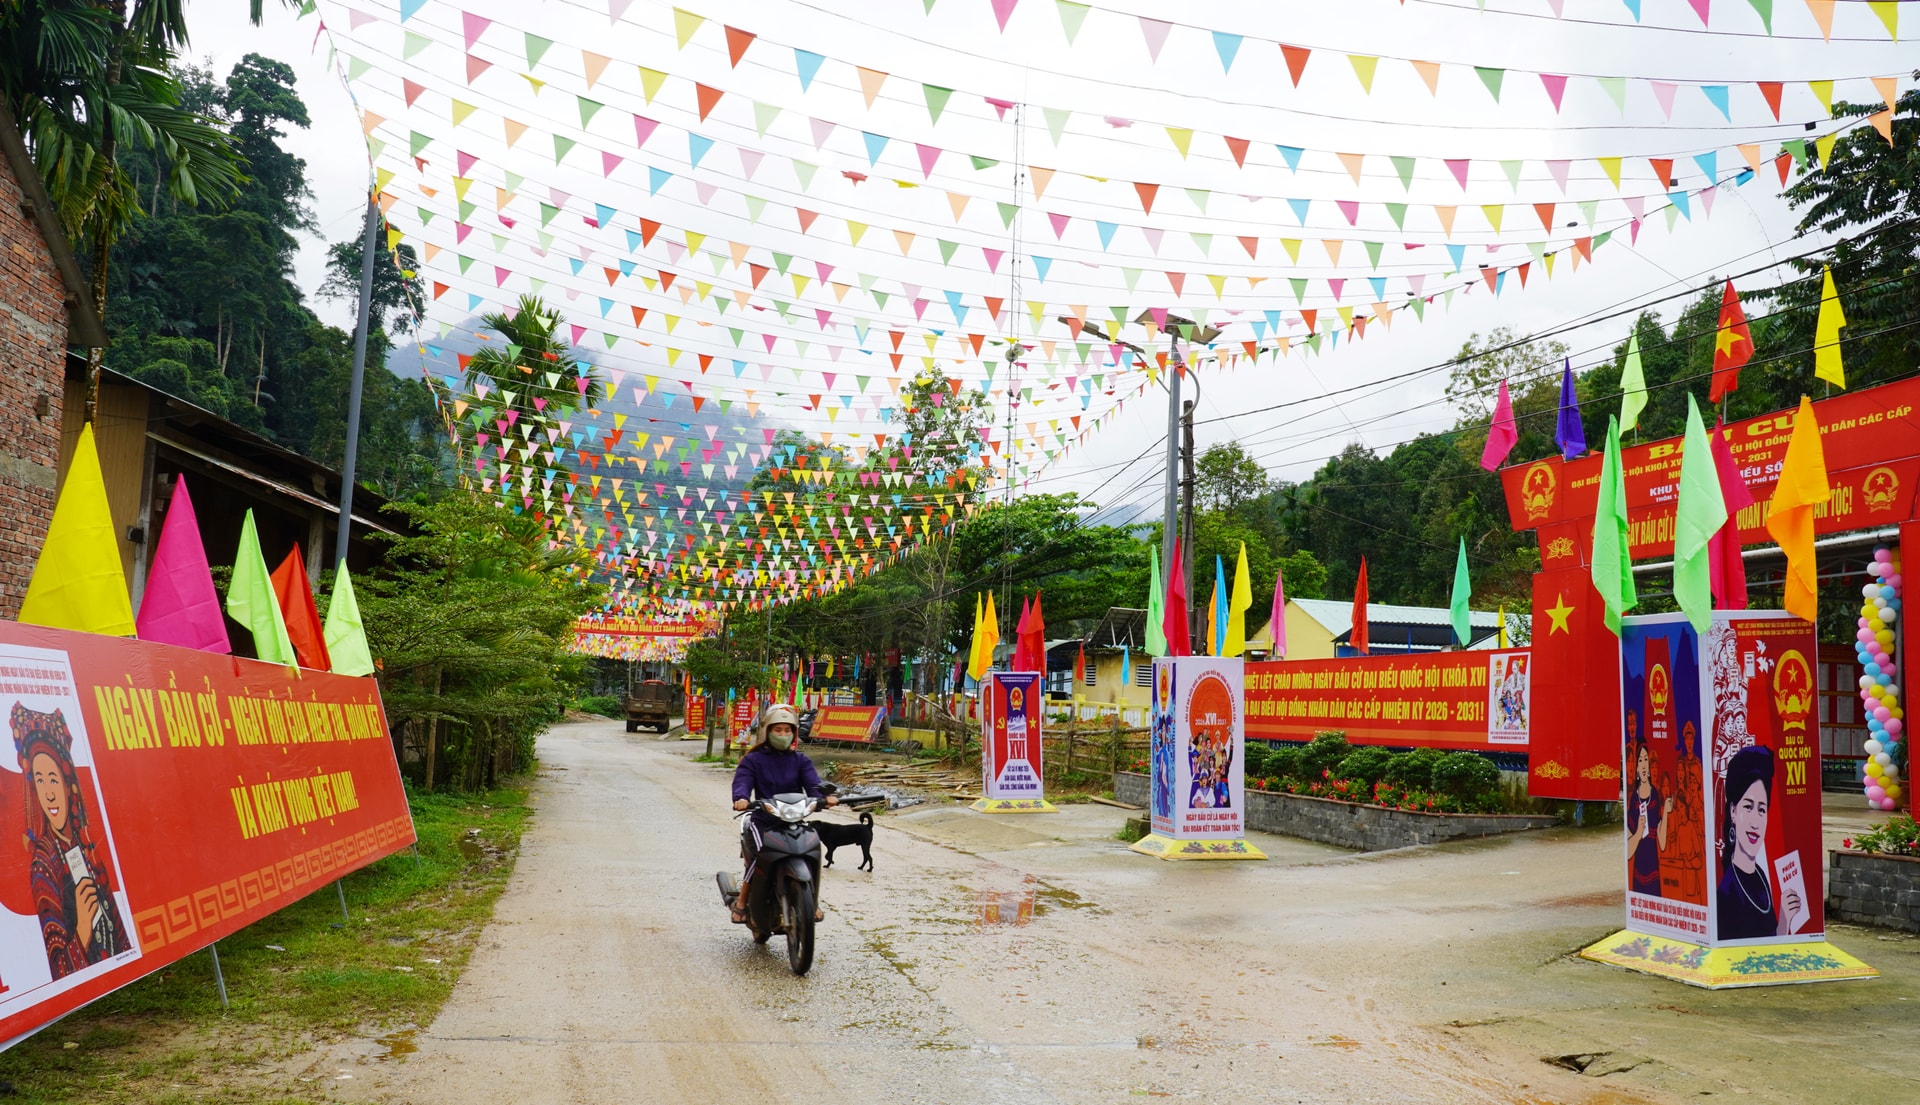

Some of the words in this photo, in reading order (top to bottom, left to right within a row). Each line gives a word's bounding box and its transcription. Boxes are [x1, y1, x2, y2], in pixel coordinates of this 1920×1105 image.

[1586, 473, 1601, 485] BIỂ
[1670, 458, 1682, 467] XV
[1831, 419, 1856, 432] DÂN
[1859, 413, 1883, 426] CÁC
[1886, 404, 1912, 419] CẤP
[1748, 451, 1772, 463] 2031
[1649, 484, 1672, 496] KHU
[1641, 512, 1656, 545] BẦU
[1658, 509, 1669, 542] CỬ
[1260, 671, 1273, 693] LIỆT
[1274, 670, 1291, 689] CHÀO
[1292, 669, 1312, 689] MỪNG
[1313, 668, 1333, 689] NGÀY
[1334, 665, 1350, 689] BẦU
[1351, 665, 1363, 689] CỬ
[1363, 670, 1378, 692] ĐẠI
[1379, 662, 1398, 688] BIỂU
[1400, 662, 1423, 690] QUỐC
[1425, 664, 1440, 692] HỘI
[1442, 663, 1467, 687] KHÓA
[1470, 666, 1486, 687] XVI
[93, 674, 162, 750] NGÀY
[158, 670, 201, 748] BẦU
[196, 675, 224, 747] CỬ
[224, 719, 231, 729] -
[228, 687, 268, 745] NGÀY
[262, 689, 289, 755] HỘI
[284, 686, 311, 744] CỦA
[304, 689, 334, 742] NIỀM
[344, 696, 371, 740] ĐOÀN
[364, 693, 383, 738] KẾT
[1261, 694, 1275, 716] BIỂU
[1276, 697, 1287, 720] HỘI
[1288, 695, 1307, 717] ĐỒNG
[1308, 697, 1328, 717] NHÂN
[1329, 697, 1346, 718] DÂN
[1347, 697, 1362, 719] CÁC
[1364, 695, 1381, 719] CẤP
[1382, 697, 1410, 724] NHIỆM
[1412, 697, 1424, 720] KỲ
[1425, 701, 1448, 720] 2026
[1009, 740, 1026, 760] XVI
[1786, 761, 1806, 786] XVI
[230, 775, 260, 840] VÀ
[251, 771, 289, 835] KHÁT
[282, 777, 318, 835] VỌNG
[310, 765, 337, 826] VIỆT
[330, 770, 360, 814] NAM!
